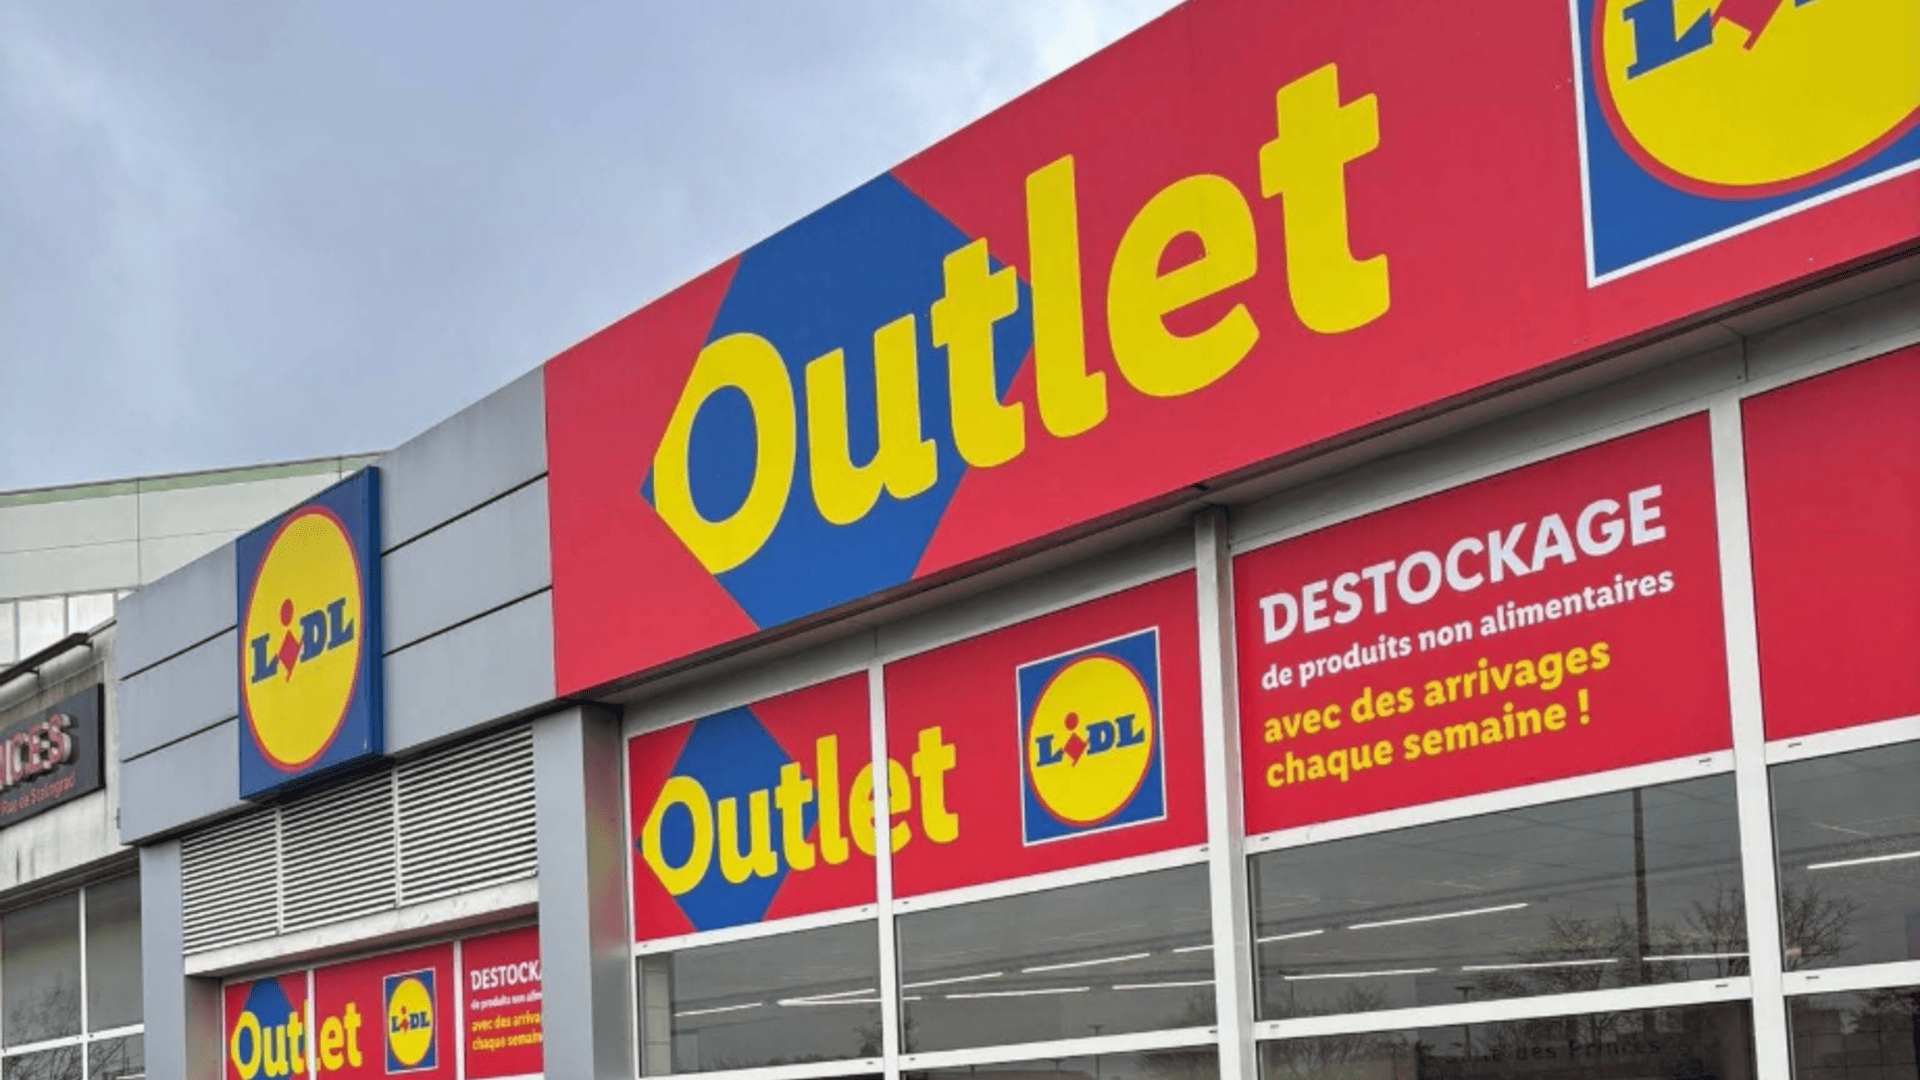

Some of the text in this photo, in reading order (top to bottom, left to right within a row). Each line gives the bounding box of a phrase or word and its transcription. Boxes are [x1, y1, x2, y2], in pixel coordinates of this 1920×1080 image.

[653, 62, 1391, 575] Outlet
[1259, 485, 1666, 644] DESTOCKAGE
[1261, 570, 1674, 690] de produits non alimentaires
[1264, 641, 1611, 743] avec des arrivages
[1266, 688, 1591, 788] chaque semaine !
[641, 725, 959, 896] Outlet
